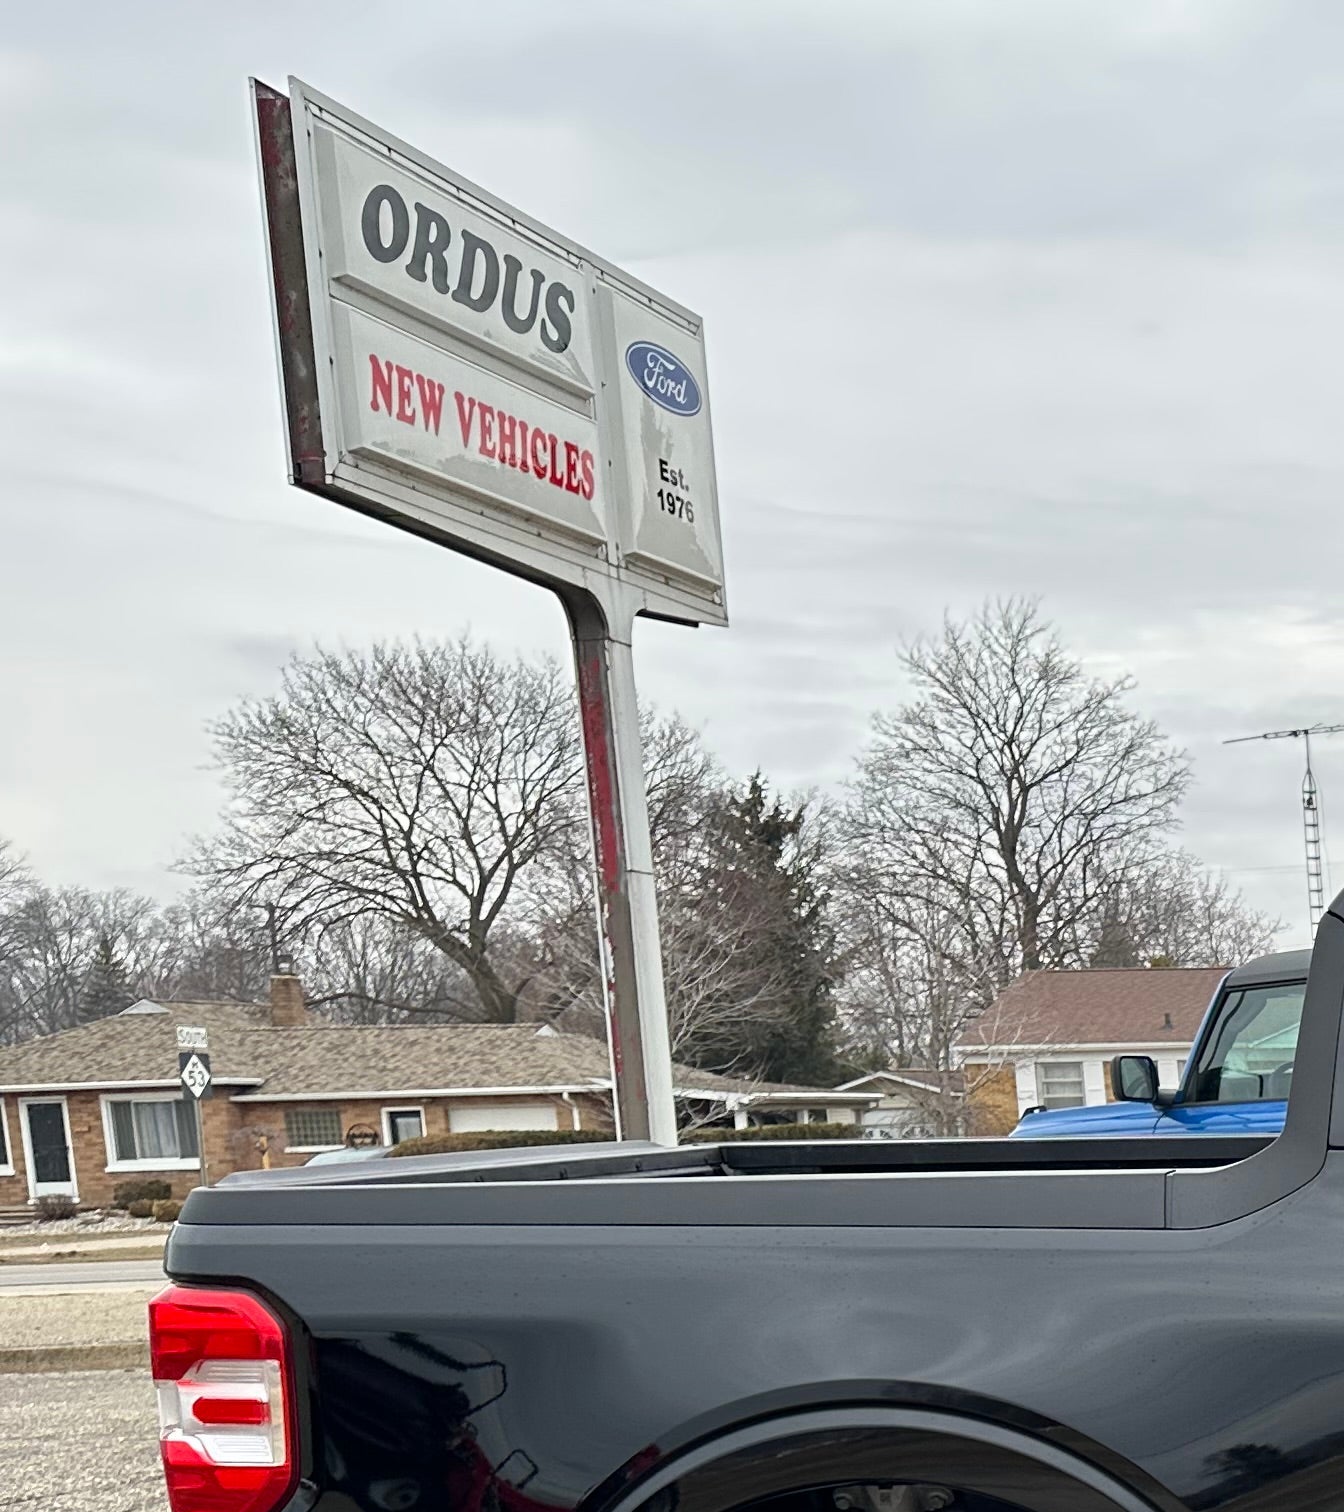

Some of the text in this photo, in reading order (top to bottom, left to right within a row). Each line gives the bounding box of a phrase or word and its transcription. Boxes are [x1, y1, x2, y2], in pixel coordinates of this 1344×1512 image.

[361, 184, 575, 354] ORDUS
[643, 351, 688, 405] Ford
[369, 353, 595, 501] NEW VEHICLES
[658, 458, 690, 492] Est.
[657, 488, 695, 523] 1976
[188, 1070, 206, 1087] 53
